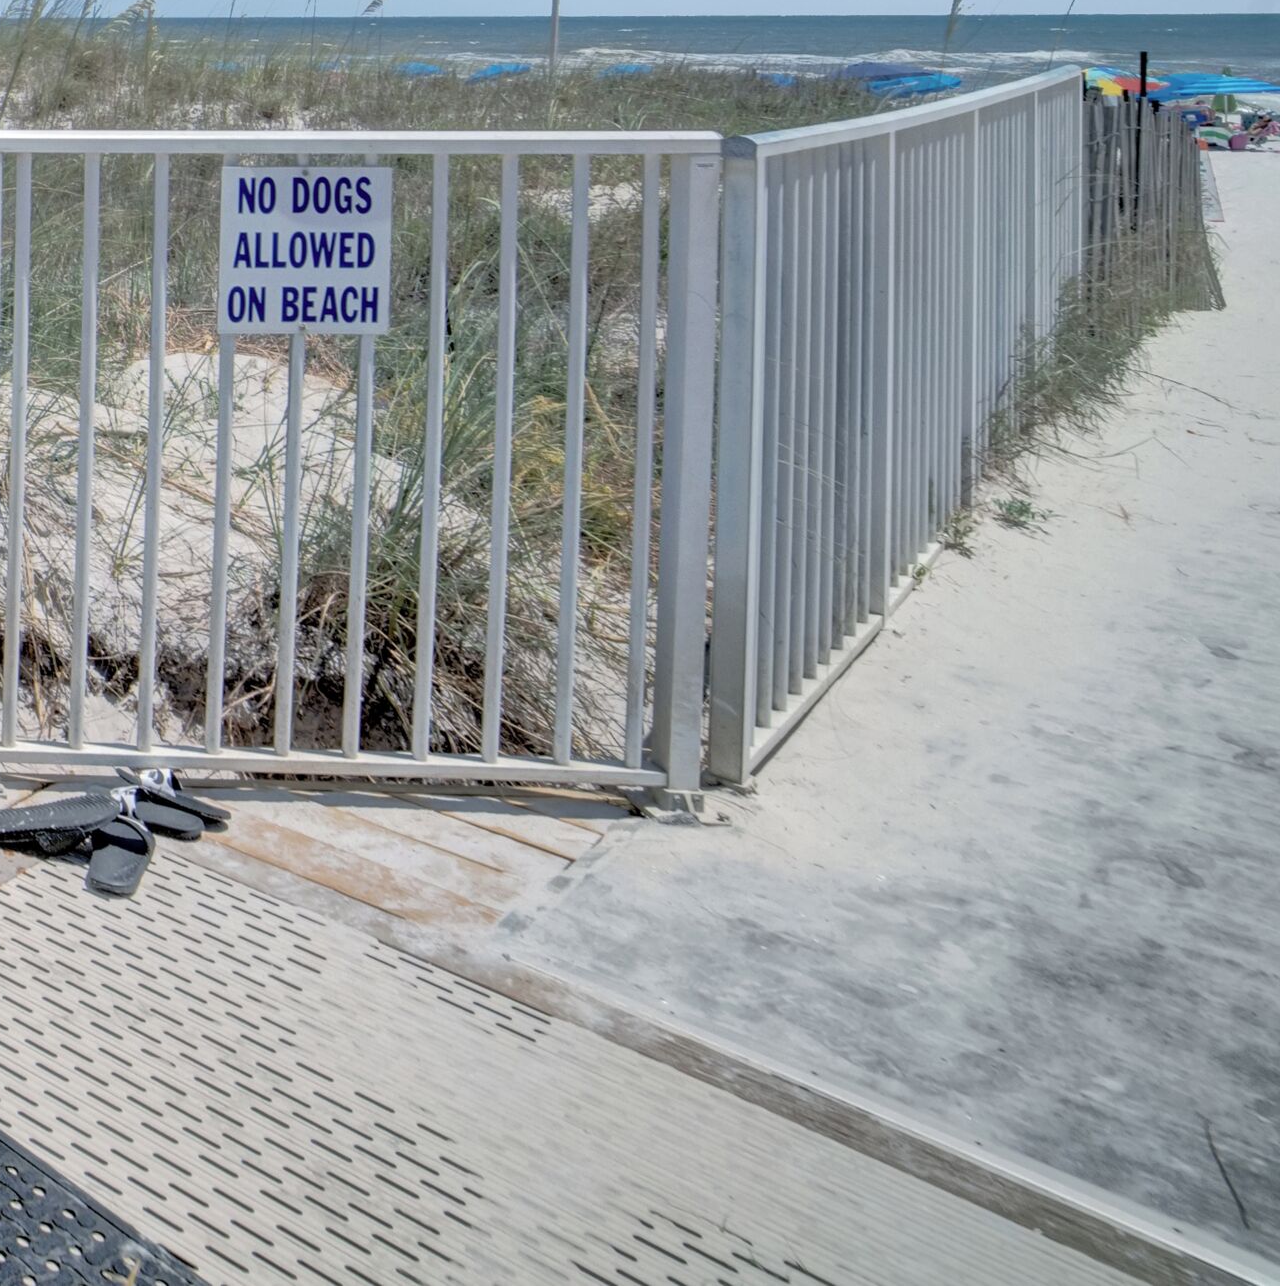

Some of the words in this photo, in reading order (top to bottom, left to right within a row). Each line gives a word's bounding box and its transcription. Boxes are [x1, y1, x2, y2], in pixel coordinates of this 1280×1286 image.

[237, 176, 276, 214] NO
[291, 176, 372, 214] DOGS
[233, 231, 375, 269] ALLOWED
[226, 286, 266, 322] ON
[280, 286, 379, 322] BEACH
